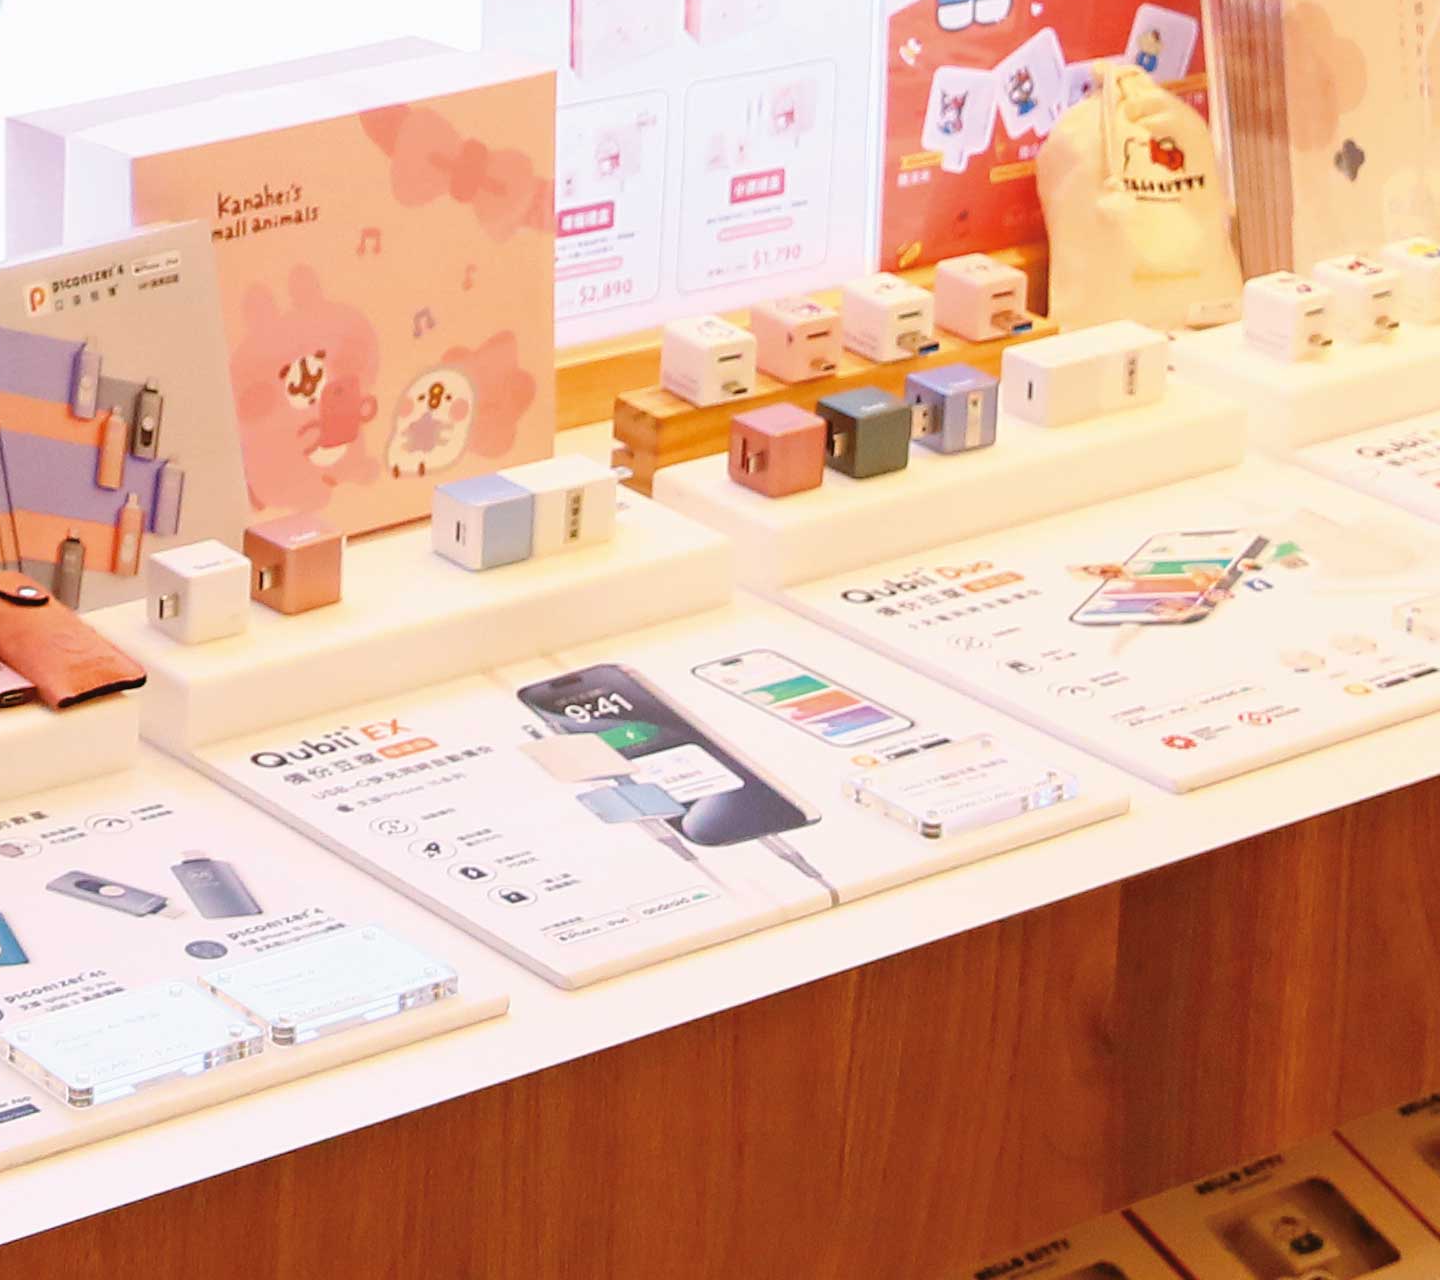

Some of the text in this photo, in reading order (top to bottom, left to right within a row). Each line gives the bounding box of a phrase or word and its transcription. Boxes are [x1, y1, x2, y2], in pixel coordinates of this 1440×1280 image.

[216, 183, 304, 219] Kanahei's
[211, 205, 318, 241] mall animals
[52, 270, 111, 294] piconizer
[840, 559, 995, 604] Qubii Duo
[564, 693, 635, 725] 9:41
[250, 726, 360, 769] Qubii
[361, 718, 413, 741] EX
[283, 750, 383, 786] 備份豆腐
[226, 916, 308, 941] piconizer
[4, 977, 84, 1003] piconizer
